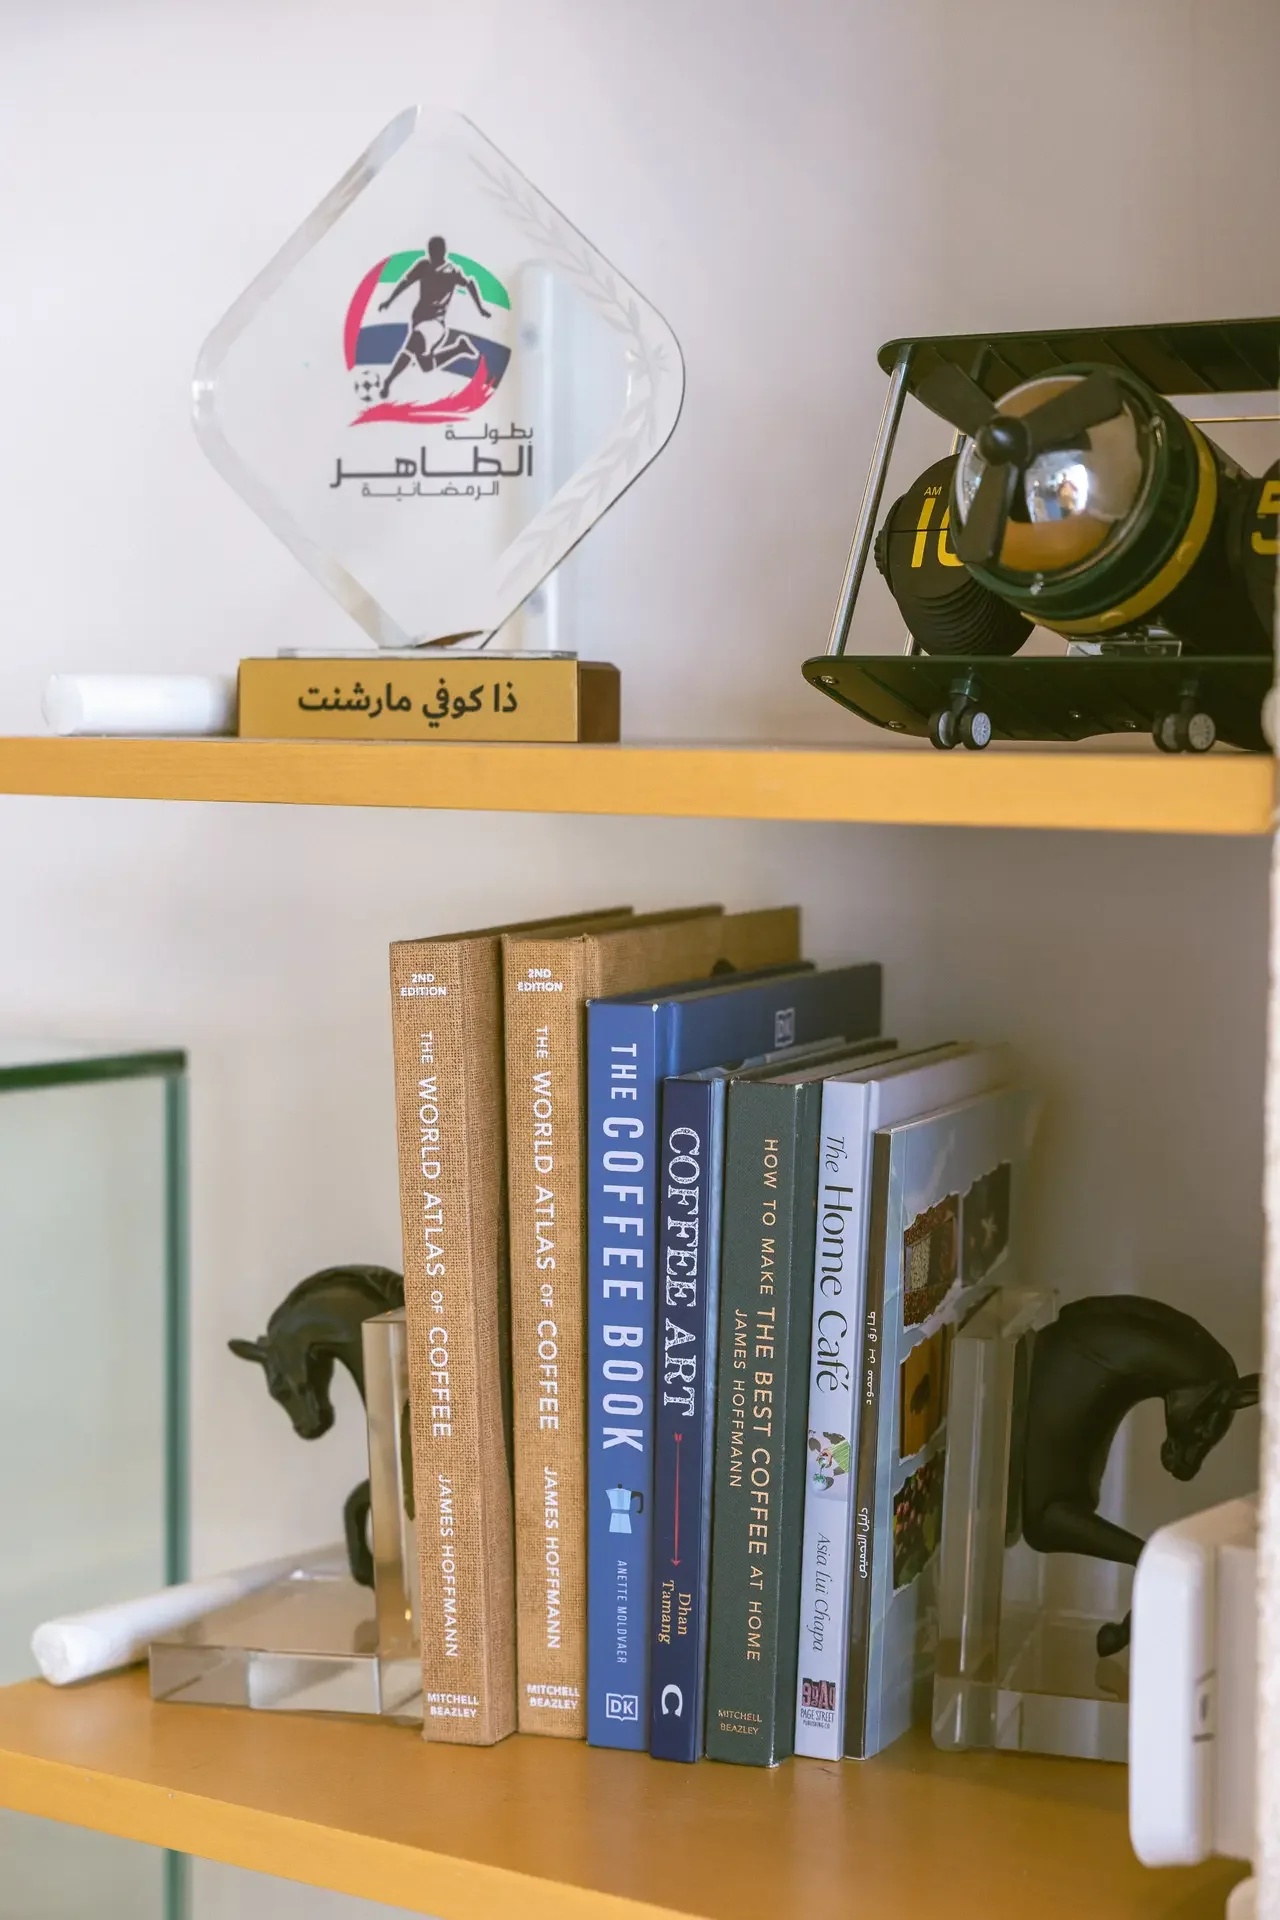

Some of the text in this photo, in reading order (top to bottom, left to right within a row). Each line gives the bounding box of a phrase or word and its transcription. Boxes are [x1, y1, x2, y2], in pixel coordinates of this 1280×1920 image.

[445, 422, 533, 444] بطولة
[330, 444, 534, 488] الطاهر
[361, 481, 500, 501] الرمضانية
[924, 486, 942, 496] AM
[297, 678, 518, 728] ذا كوفي مارشنت
[411, 973, 435, 983] 2ND
[517, 981, 563, 992] EDITION
[527, 968, 552, 978] 2ND
[400, 986, 447, 997] EDITION
[418, 1031, 452, 1438] THE WORLD ATLAS OF COFFEE
[532, 1025, 559, 1430] THE WORLD ATLAS OF COFFEE
[602, 1043, 645, 1452] THE COFFEE BOOK
[663, 1127, 700, 1418] COFFEE ART
[816, 1136, 854, 1394] The Home Café
[866, 1311, 877, 1405] طارق بن محمود
[729, 1309, 749, 1488] JAMES HOFFMANN
[746, 1138, 779, 1661] HOW TO MAKE THE BEST COFFEE AT HOME
[858, 1507, 870, 1532] دليل
[438, 1473, 459, 1657] JAMES HOFFMANN
[544, 1466, 561, 1649] JAMES HOFFMANN
[806, 1532, 833, 1652] Asia Lui Chapa
[616, 1560, 628, 1664] ANETTE MOLDVAER
[658, 1580, 676, 1645] Tamang
[677, 1593, 692, 1636] Dhan
[427, 1693, 479, 1705] MITCHELL
[526, 1683, 580, 1697] MITCHELL
[529, 1696, 577, 1710] BEAZLEY
[430, 1705, 477, 1718] BEAZLEY
[610, 1700, 634, 1715] DK
[718, 1709, 762, 1722] MITCHELL
[800, 1708, 836, 1723] PAGE STREET
[720, 1723, 759, 1736] BEAZLEY
